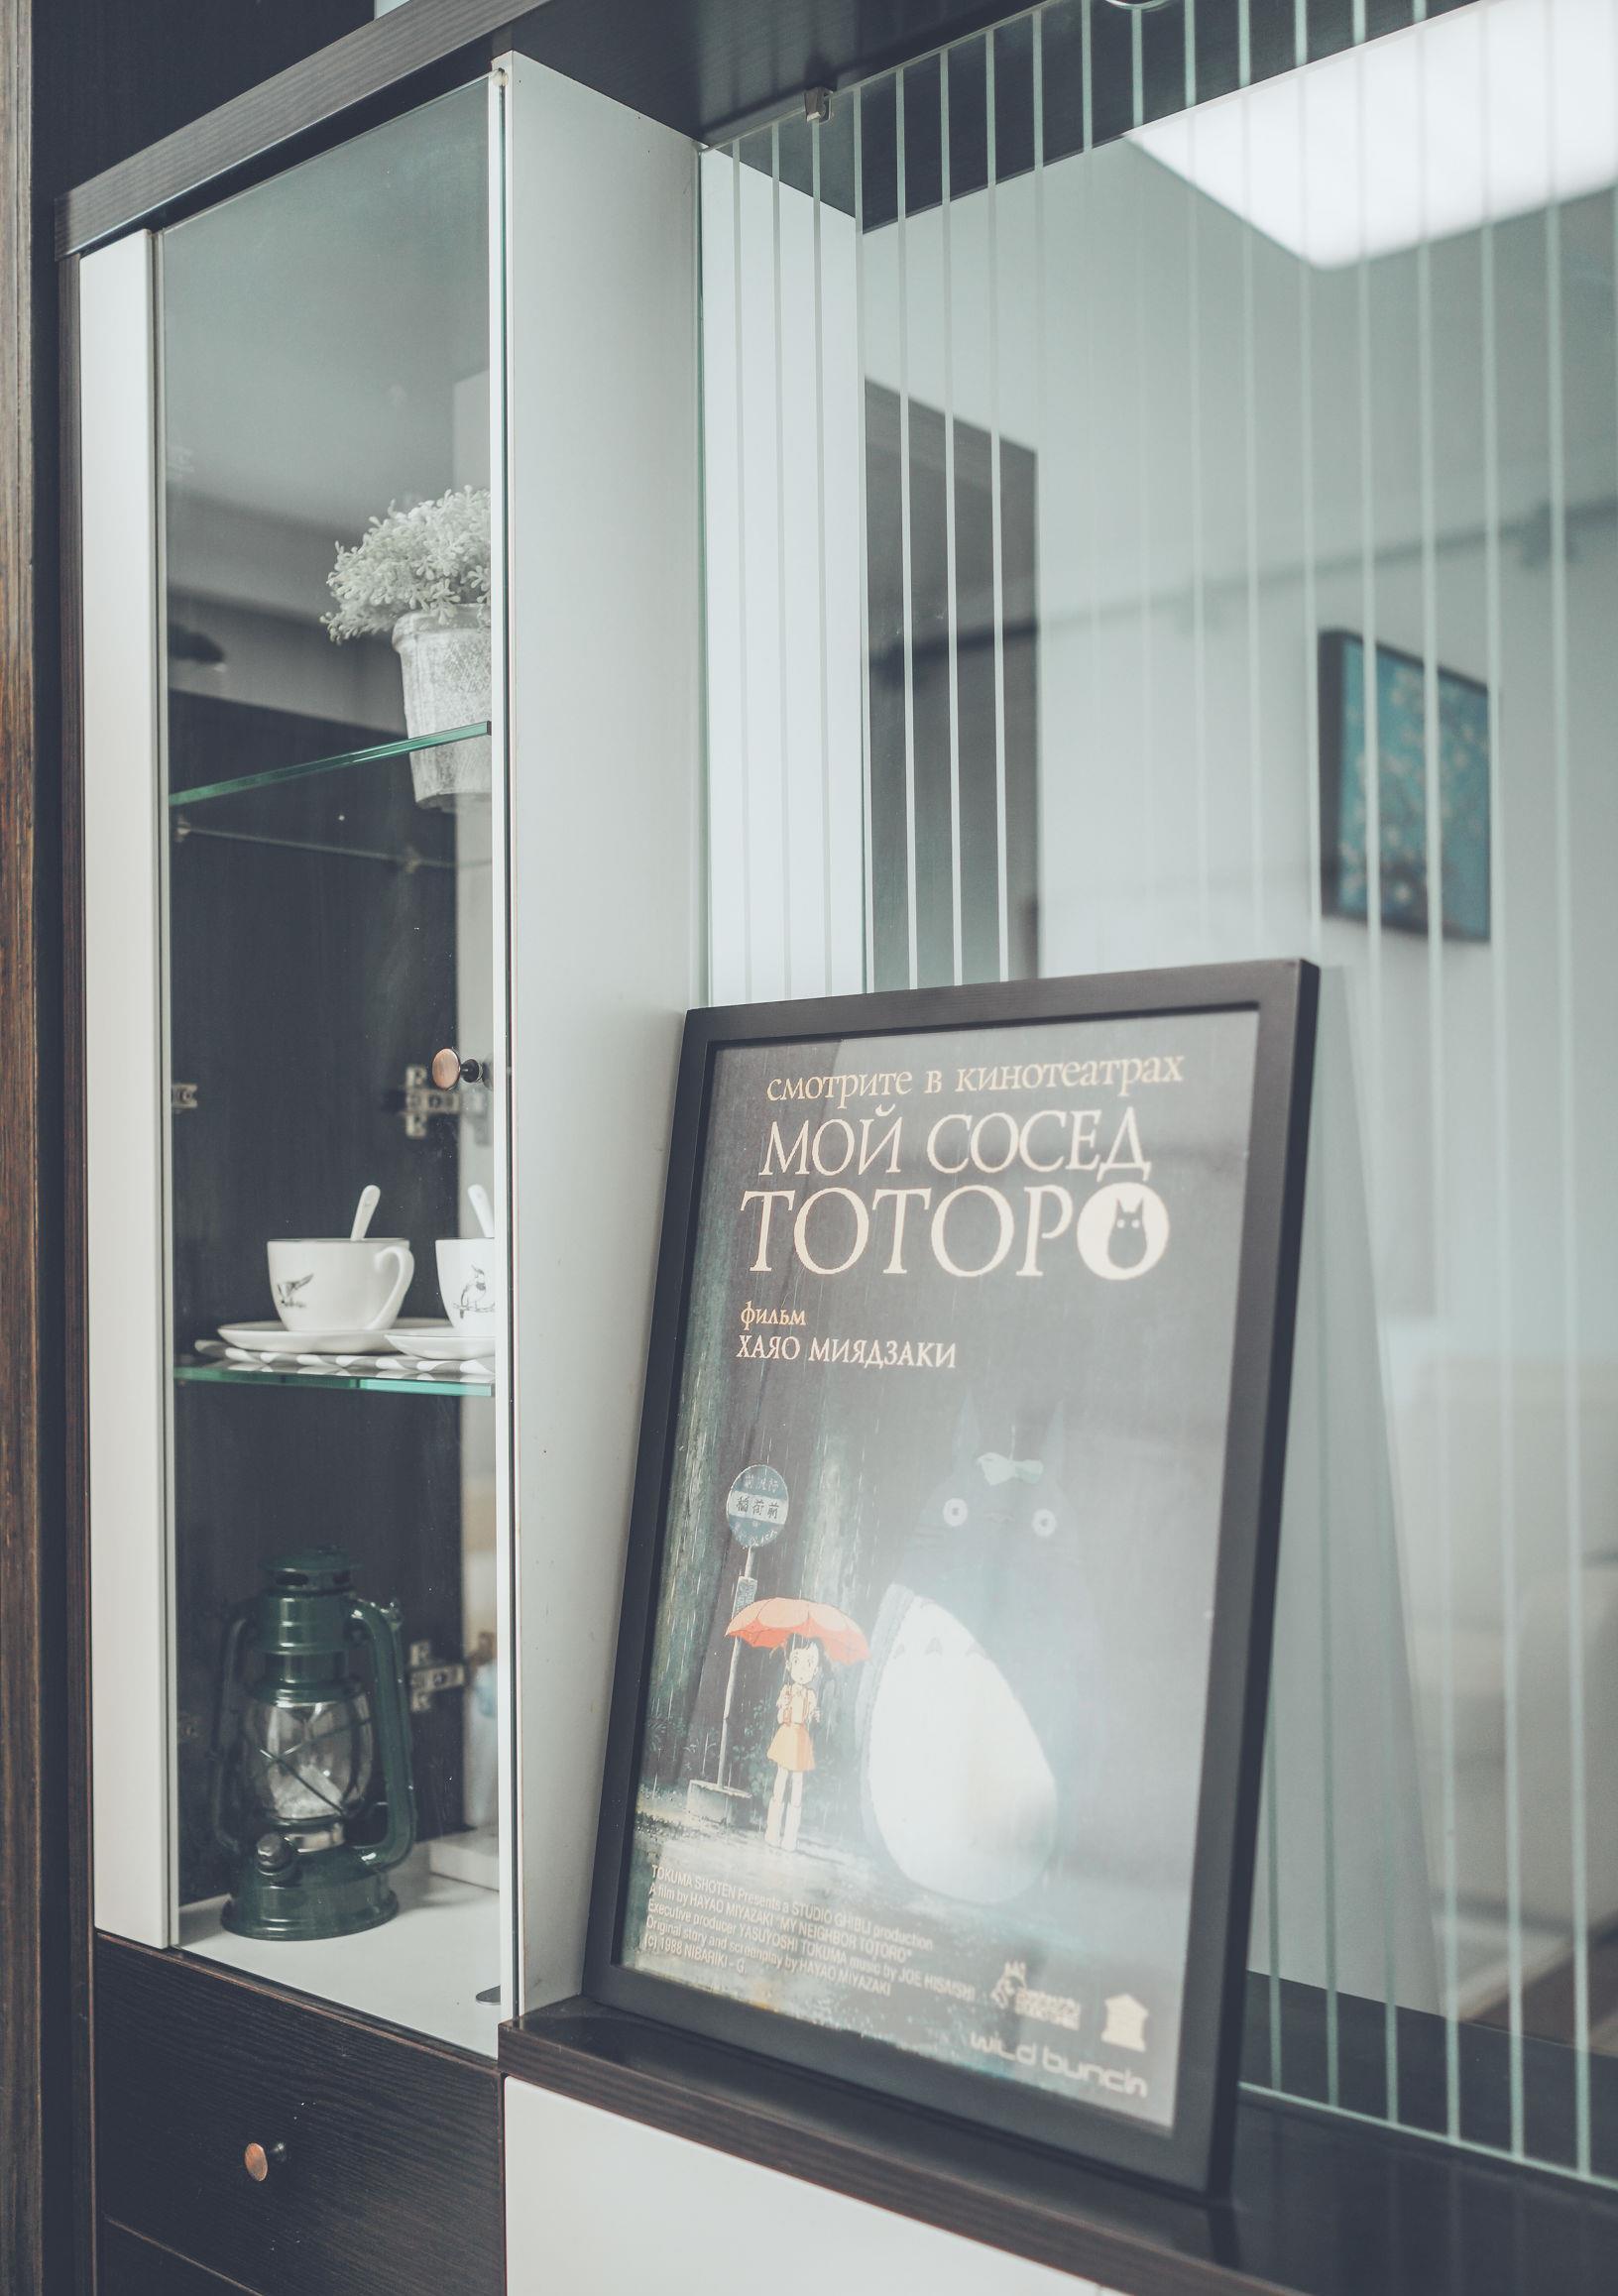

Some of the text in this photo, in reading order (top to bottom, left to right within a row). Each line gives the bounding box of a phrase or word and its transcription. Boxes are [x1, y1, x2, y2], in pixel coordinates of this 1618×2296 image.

[767, 1055, 1185, 1109] смотрите в кинотеатрах
[758, 1104, 1152, 1182] МОЙ СОСЕД
[741, 1301, 807, 1331] фильм
[736, 1334, 957, 1369] ХАЯО МИЯДЗАКИ
[647, 1897, 692, 1923] Executive
[693, 1912, 737, 1935] producer
[740, 1923, 798, 1952] YASUYOSHI
[801, 1938, 847, 1967] TOKUMA
[651, 1864, 693, 1888] TOKUMA
[694, 1875, 737, 1899] SHOTEN
[738, 1888, 781, 1911] Presents
[791, 1901, 833, 1925] STUDIO
[834, 1910, 871, 1935] GHIBLI
[872, 1924, 934, 1951] production
[658, 1884, 675, 1900] film
[677, 1888, 689, 1906] by
[690, 1892, 724, 1913] HAYAO
[726, 1901, 773, 1926] MIYAZAKI
[798, 1921, 857, 1950] NEIGHBOR
[646, 1914, 681, 1938] Original
[683, 1926, 708, 1947] story
[709, 1934, 728, 1950] and
[799, 1958, 837, 1981] HAYAO
[838, 1969, 891, 1997] MIYAZAKI
[660, 1937, 682, 1955] 1988
[1042, 2045, 1147, 2099] bunch
